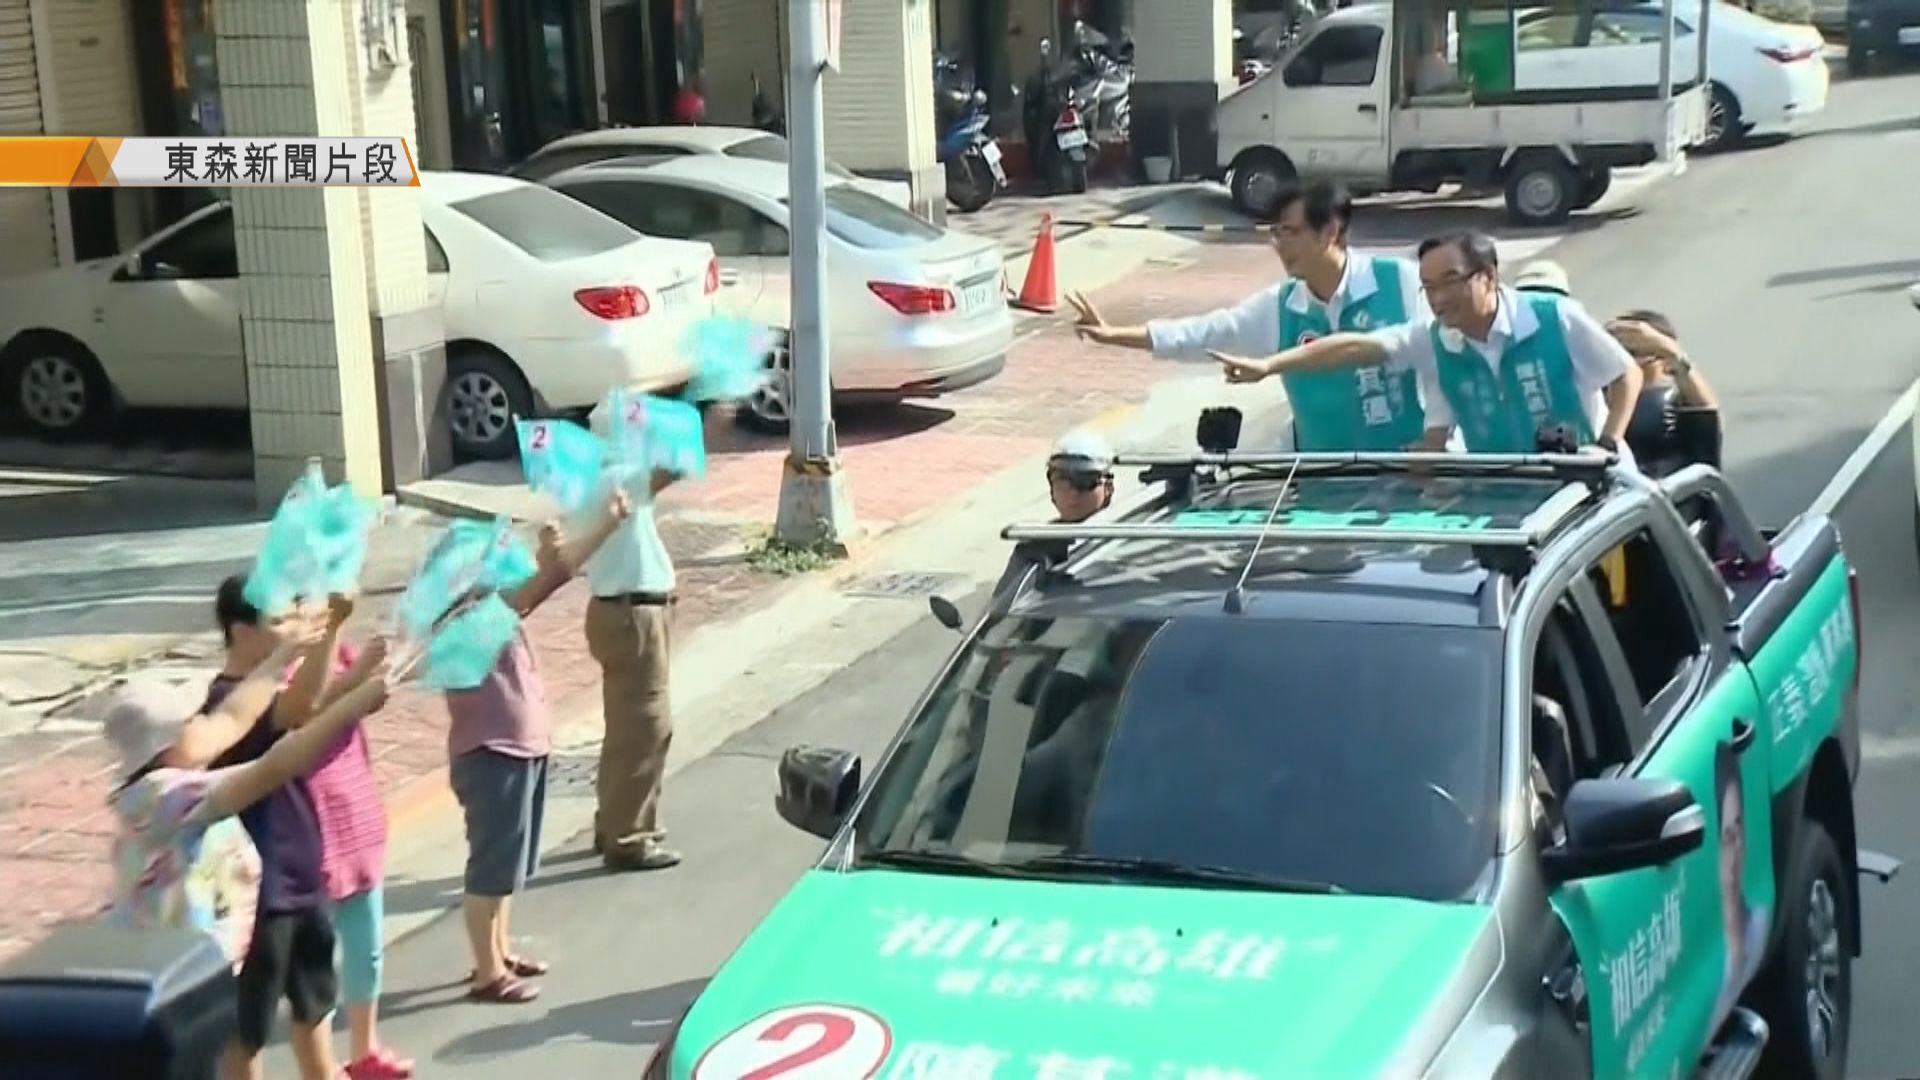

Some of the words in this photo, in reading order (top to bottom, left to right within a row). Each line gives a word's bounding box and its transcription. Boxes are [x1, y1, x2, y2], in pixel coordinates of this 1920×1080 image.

[532, 426, 546, 449] 2
[879, 912, 1286, 980] 相信高雄
[1610, 886, 1682, 1039] 相信高雄
[736, 1012, 856, 1080] 2
